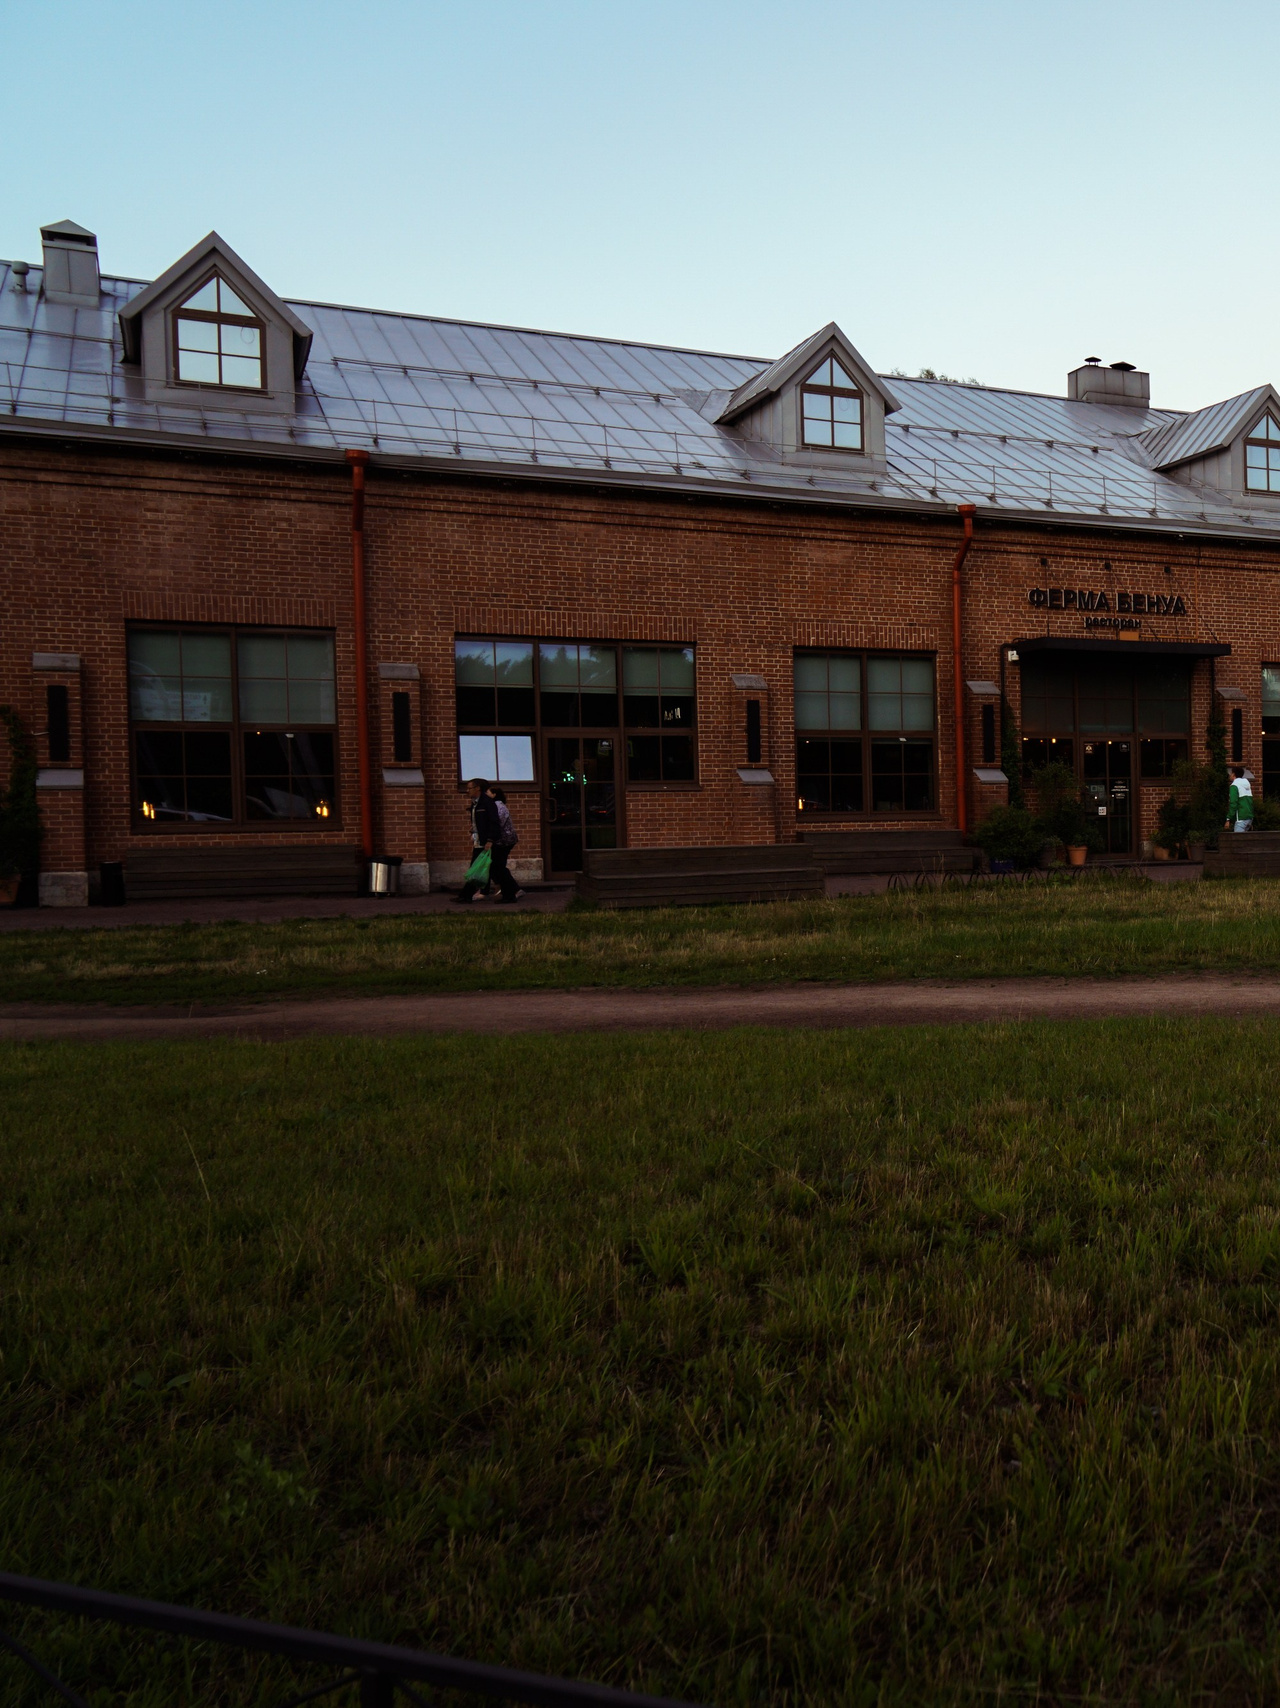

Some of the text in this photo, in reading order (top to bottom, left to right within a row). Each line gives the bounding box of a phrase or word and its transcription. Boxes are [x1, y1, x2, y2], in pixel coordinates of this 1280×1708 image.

[1029, 588, 1186, 615] ФЕРМА БЕНУА
[1085, 616, 1141, 630] ресторан
